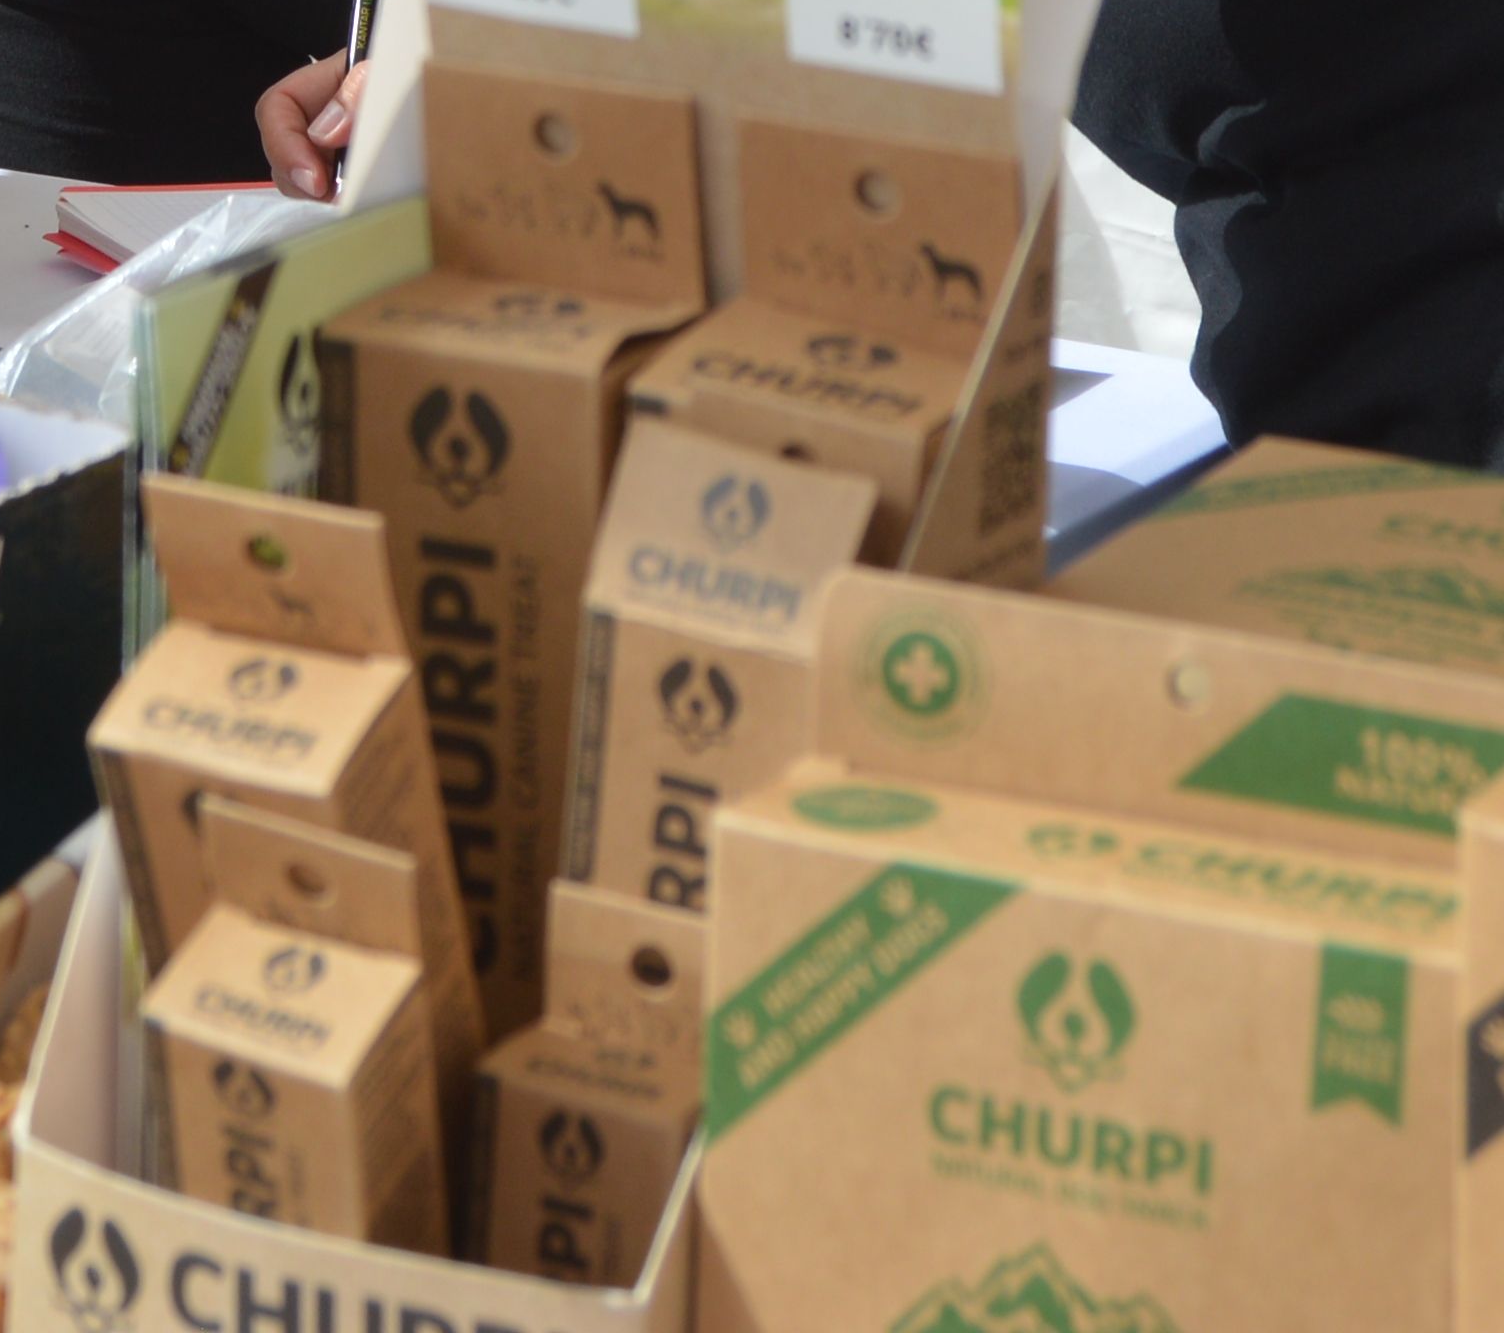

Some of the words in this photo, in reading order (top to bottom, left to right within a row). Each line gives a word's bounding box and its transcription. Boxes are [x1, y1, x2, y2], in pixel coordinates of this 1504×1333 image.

[356, 6, 373, 50] KANTAR
[626, 537, 802, 624] CHURPI
[757, 909, 874, 1016] HEALTHY
[792, 957, 883, 1047] HAPPY
[874, 896, 953, 982] DOGS
[927, 1082, 1215, 1198] CHURPI
